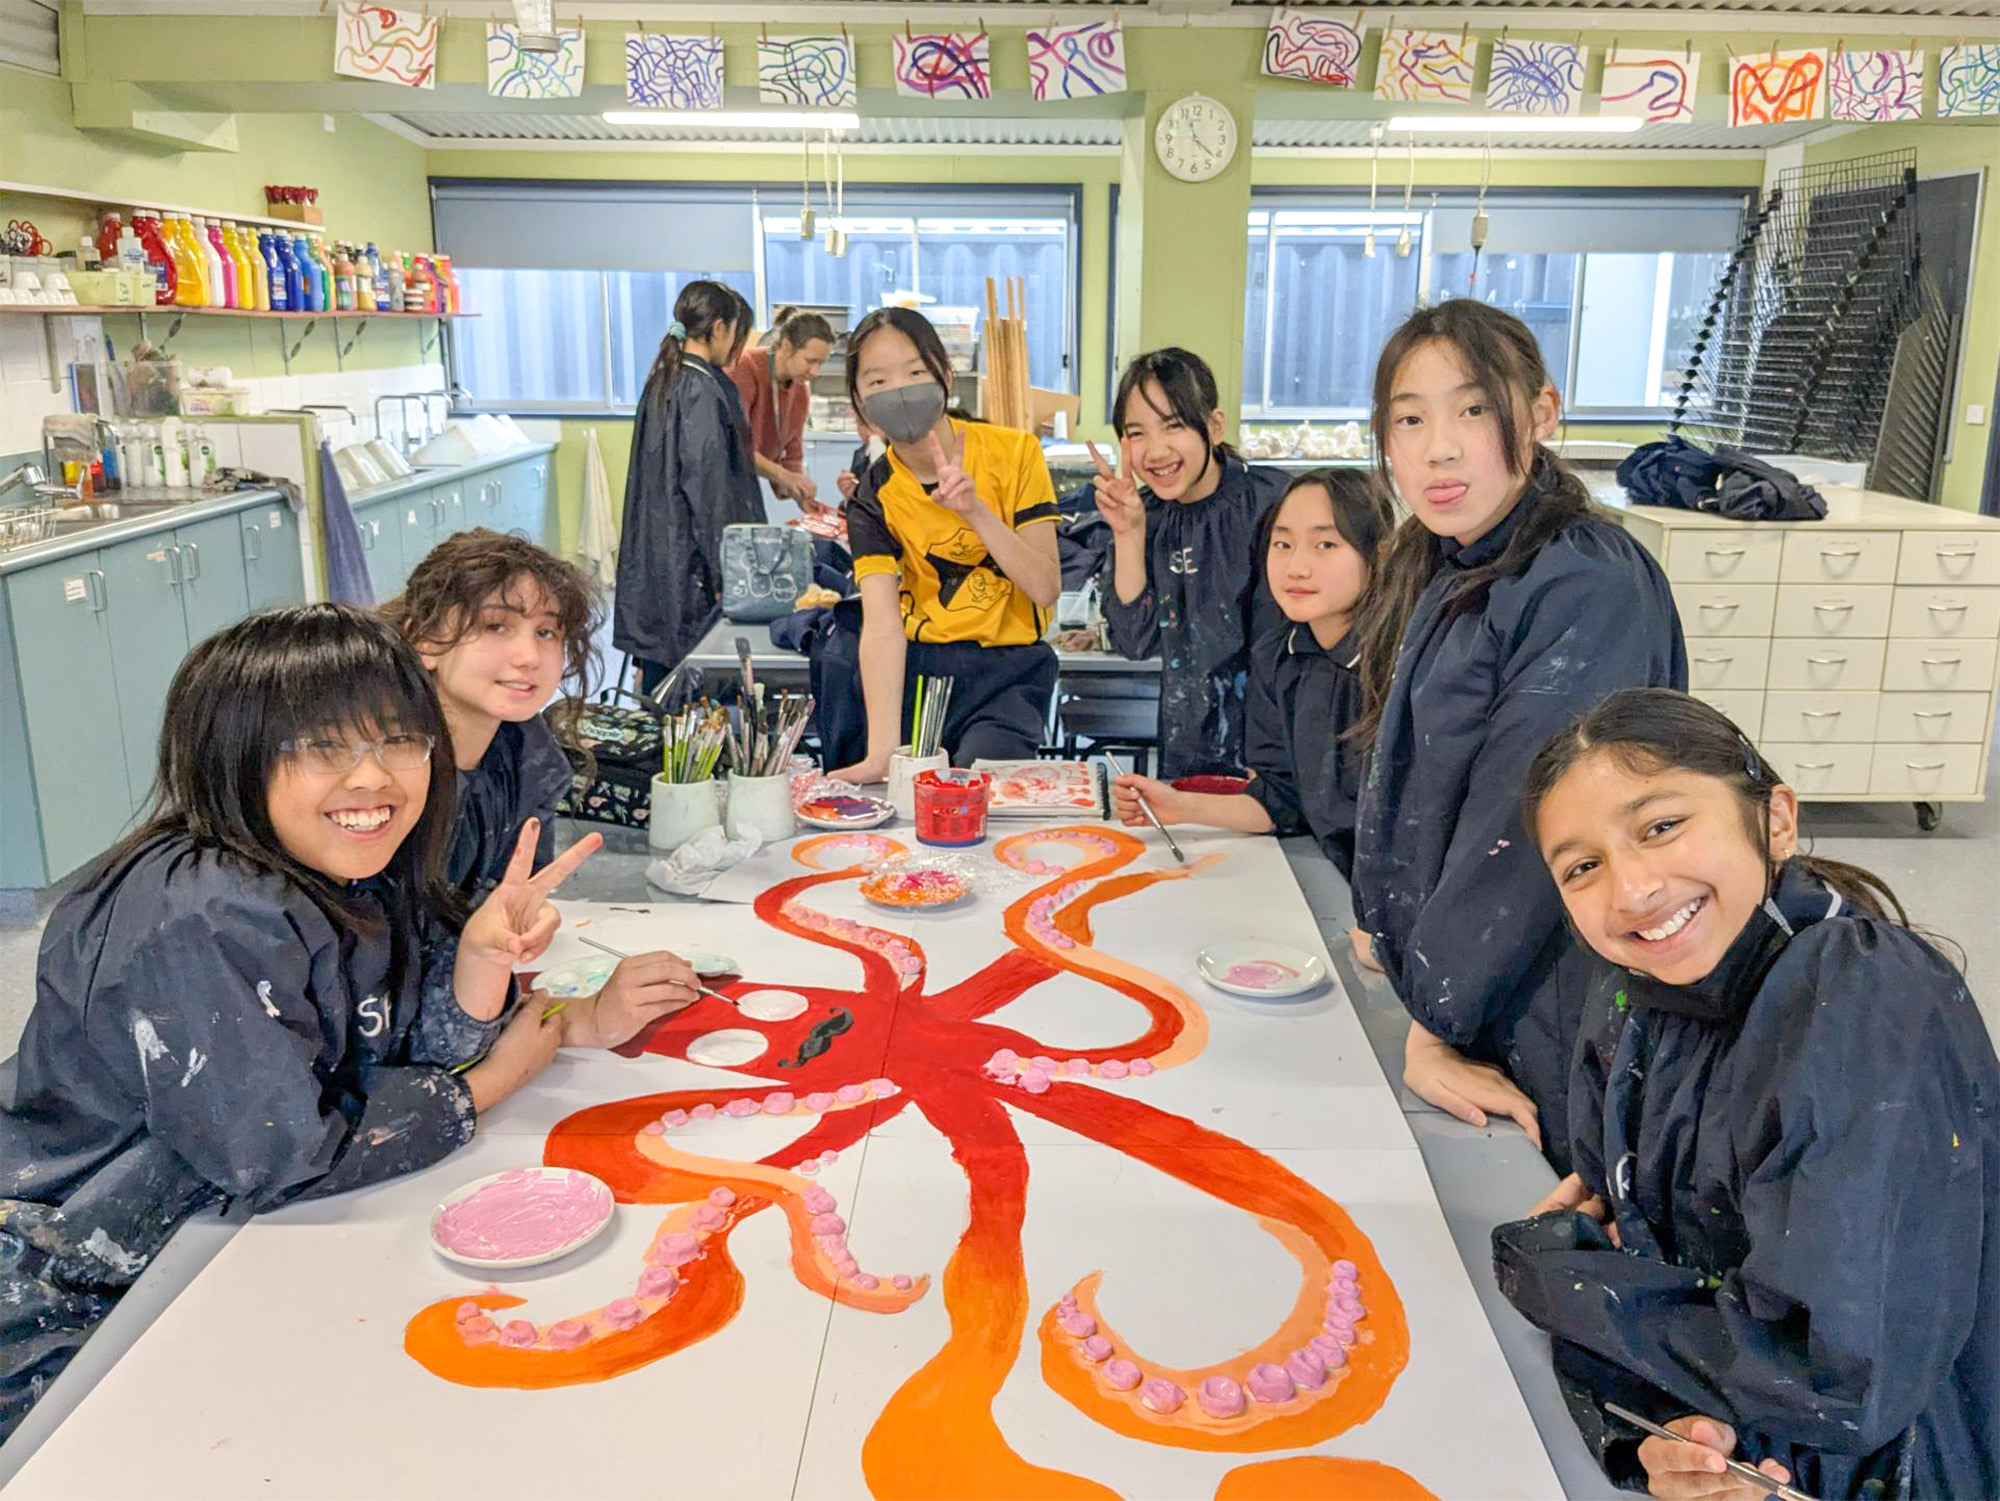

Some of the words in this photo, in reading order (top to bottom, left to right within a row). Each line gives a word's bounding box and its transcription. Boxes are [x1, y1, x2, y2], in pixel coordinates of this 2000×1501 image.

[1180, 108, 1189, 120] 11
[1193, 105, 1203, 117] 12
[1209, 108, 1213, 120] 1
[1217, 120, 1224, 131] 2
[1165, 134, 1172, 145] 9
[1218, 134, 1226, 146] 3
[1167, 147, 1174, 159] 8
[1178, 159, 1184, 169] 7
[1190, 163, 1198, 174] 6
[1204, 160, 1212, 170] 5
